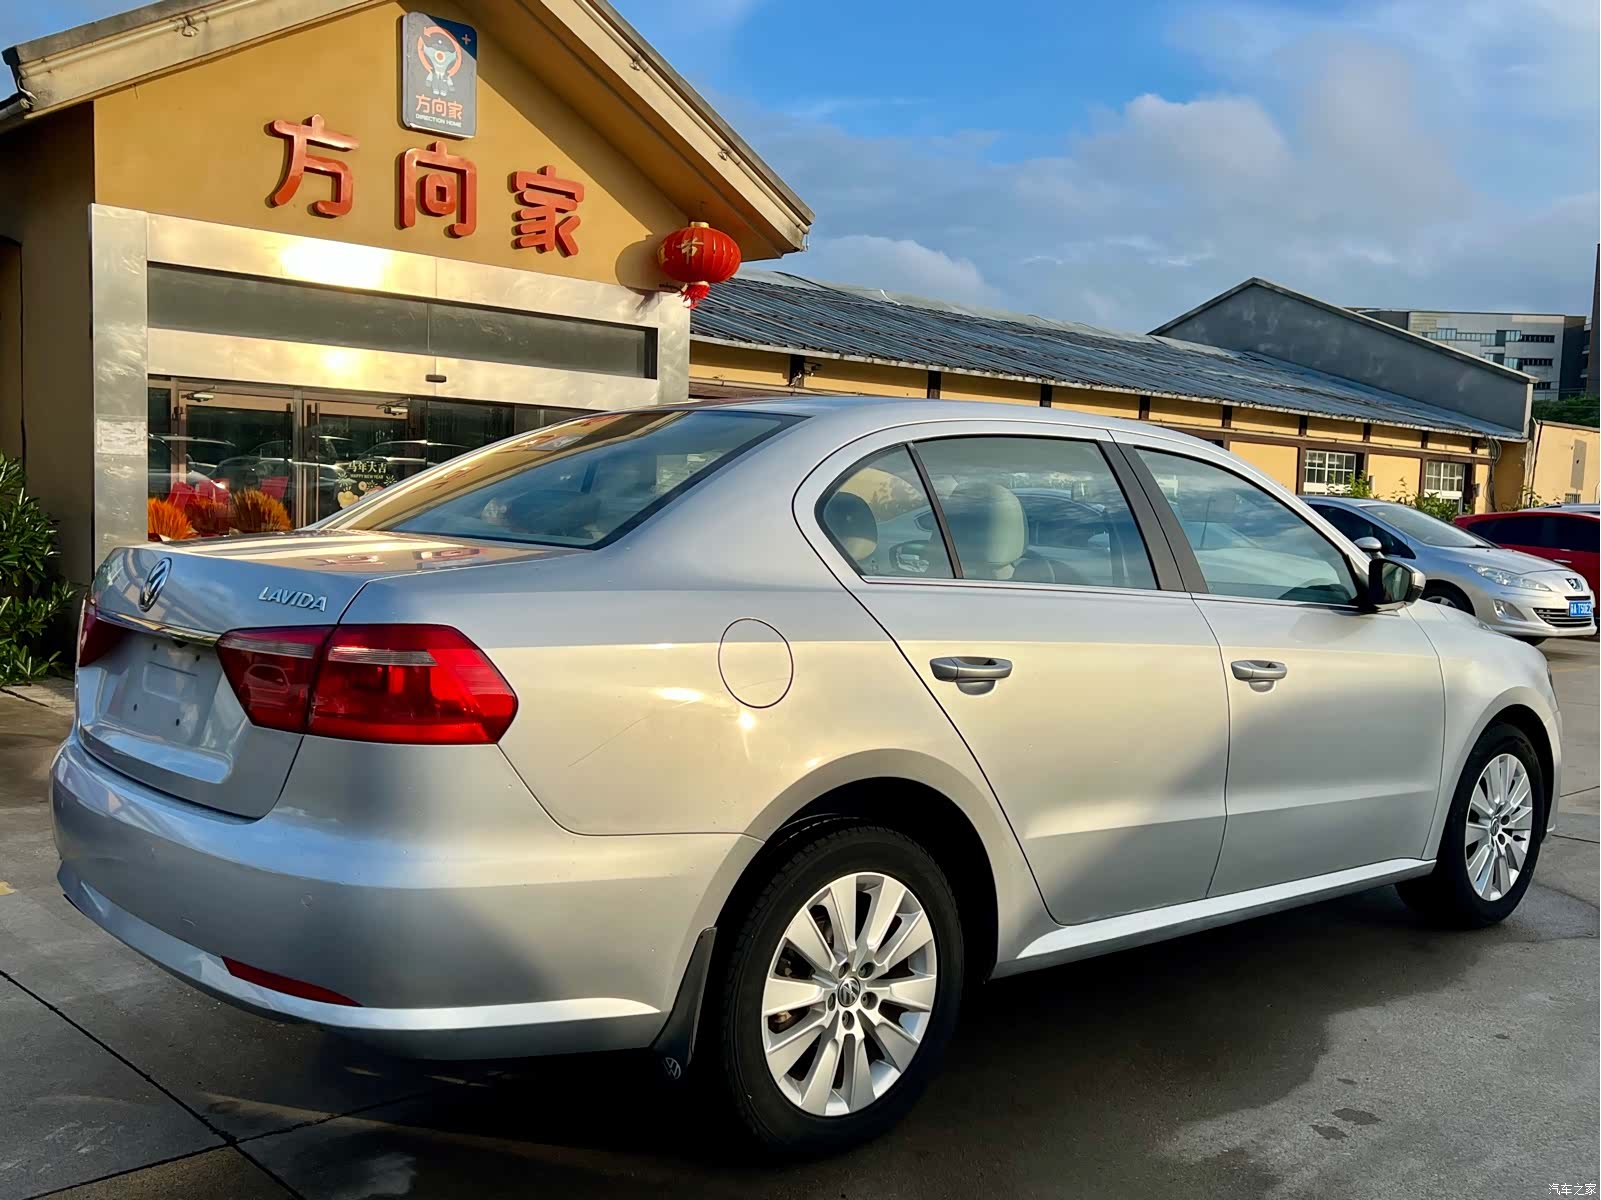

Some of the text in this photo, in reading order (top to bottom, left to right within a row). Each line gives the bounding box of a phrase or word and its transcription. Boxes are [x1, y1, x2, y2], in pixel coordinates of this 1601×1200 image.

[415, 94, 463, 120] 方向家
[415, 113, 462, 127] DIRECTION HOME
[268, 113, 584, 257] 方向家
[348, 460, 387, 473] 马年大吉
[258, 586, 328, 613] LAVIDA
